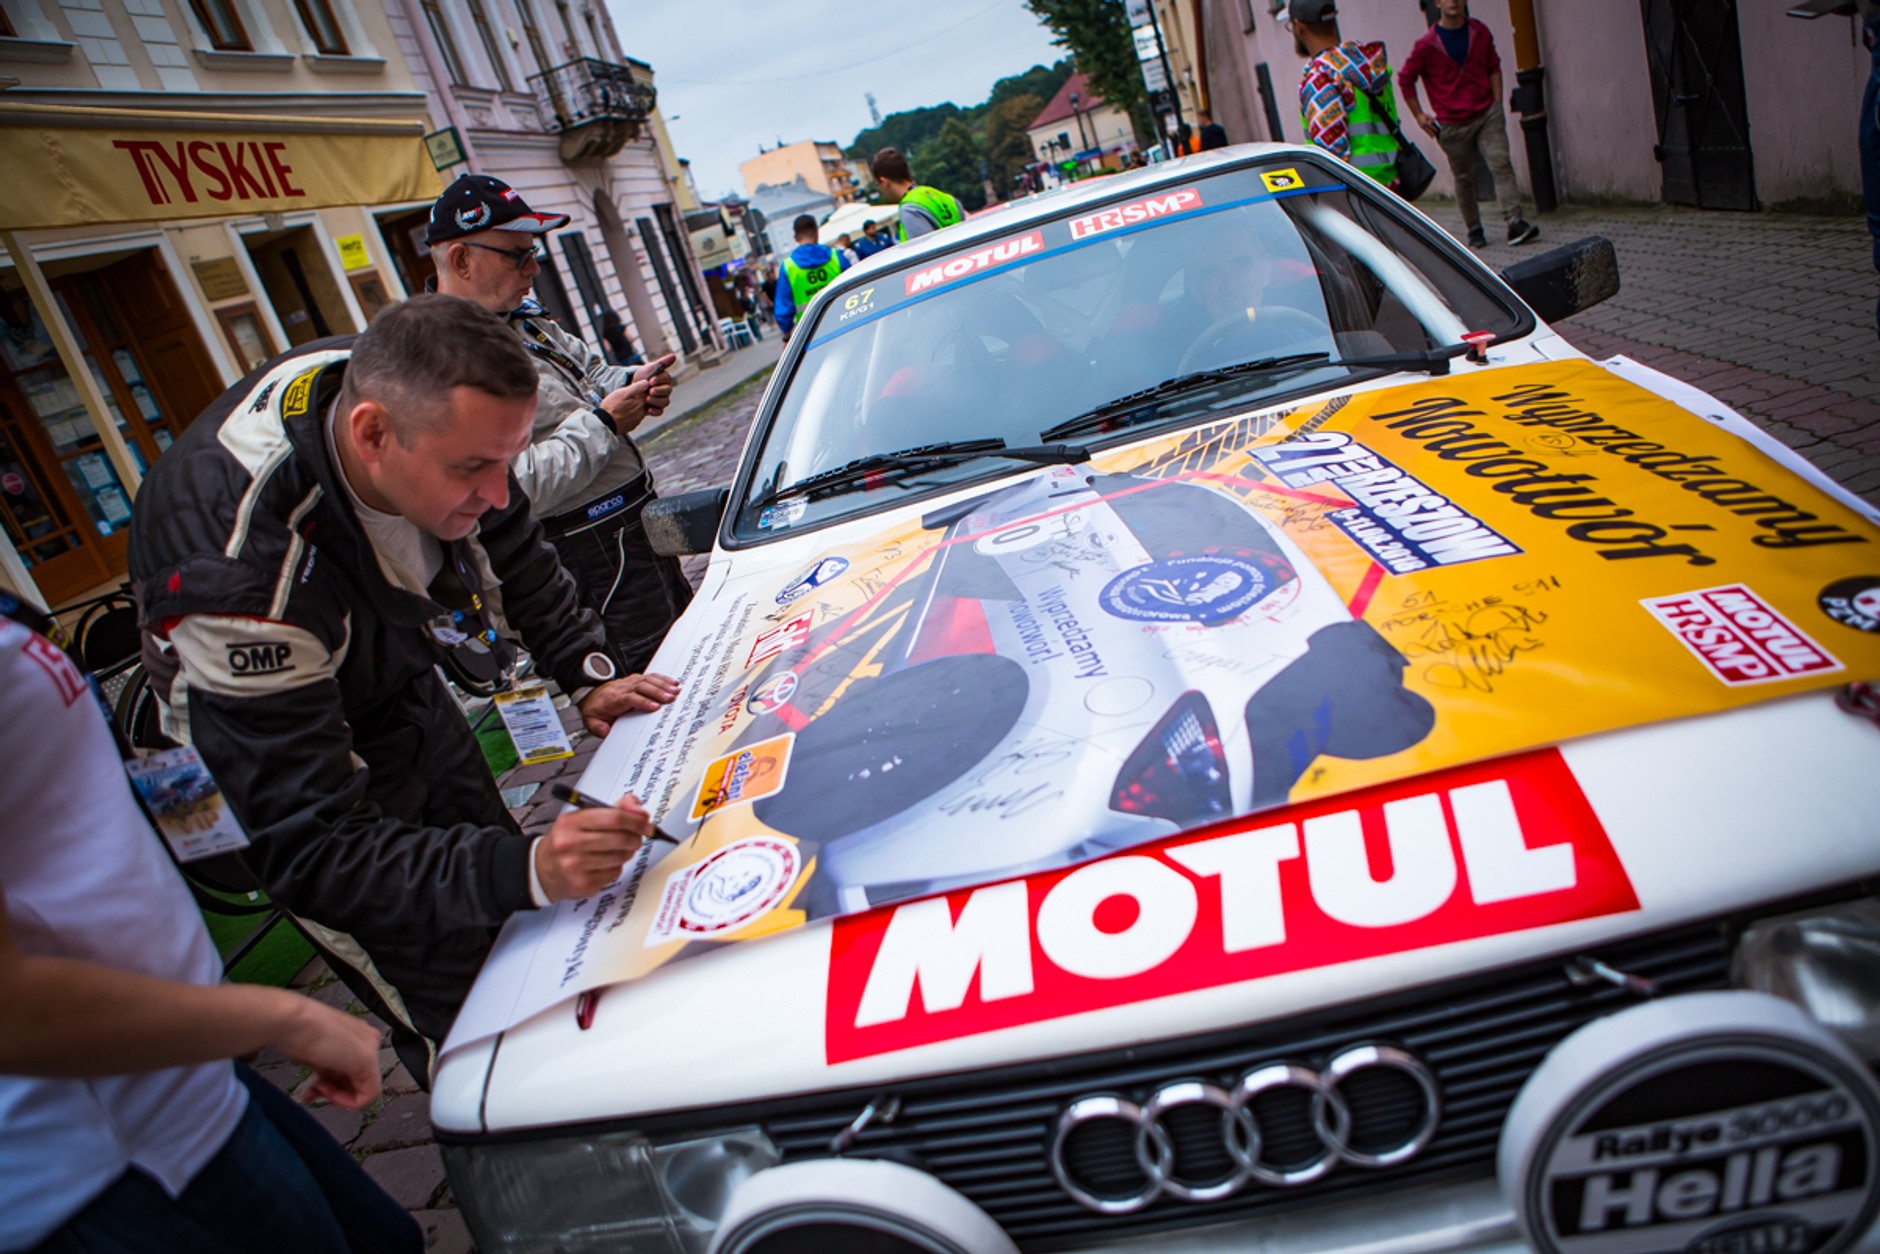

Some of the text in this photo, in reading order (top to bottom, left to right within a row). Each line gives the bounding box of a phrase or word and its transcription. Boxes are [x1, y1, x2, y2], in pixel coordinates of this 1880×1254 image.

[114, 139, 305, 205] TYSKIE
[1073, 191, 1195, 238] HRSMP
[806, 267, 828, 285] 60
[909, 236, 1041, 294] MOTUL
[844, 287, 876, 311] 67
[1250, 432, 1376, 476] 27
[1283, 453, 1388, 489] RALLY
[1369, 396, 1717, 566] Nowotwór
[1491, 383, 1871, 549] Wyprzedzamy
[587, 495, 624, 517] sparco
[1007, 599, 1065, 665] nowotwór!
[1036, 584, 1109, 679] Wyprzedzamy
[1656, 599, 1770, 678] HRSMP
[1705, 591, 1823, 671] MOTUL
[1821, 596, 1879, 630] PZM
[229, 645, 291, 670] OMP
[717, 684, 749, 736] TOYOTA
[177, 811, 220, 834] VIP
[853, 779, 1578, 1028] MOTUL
[1592, 1092, 1849, 1161] Rallye 3000
[1578, 1141, 1842, 1232] Hella
